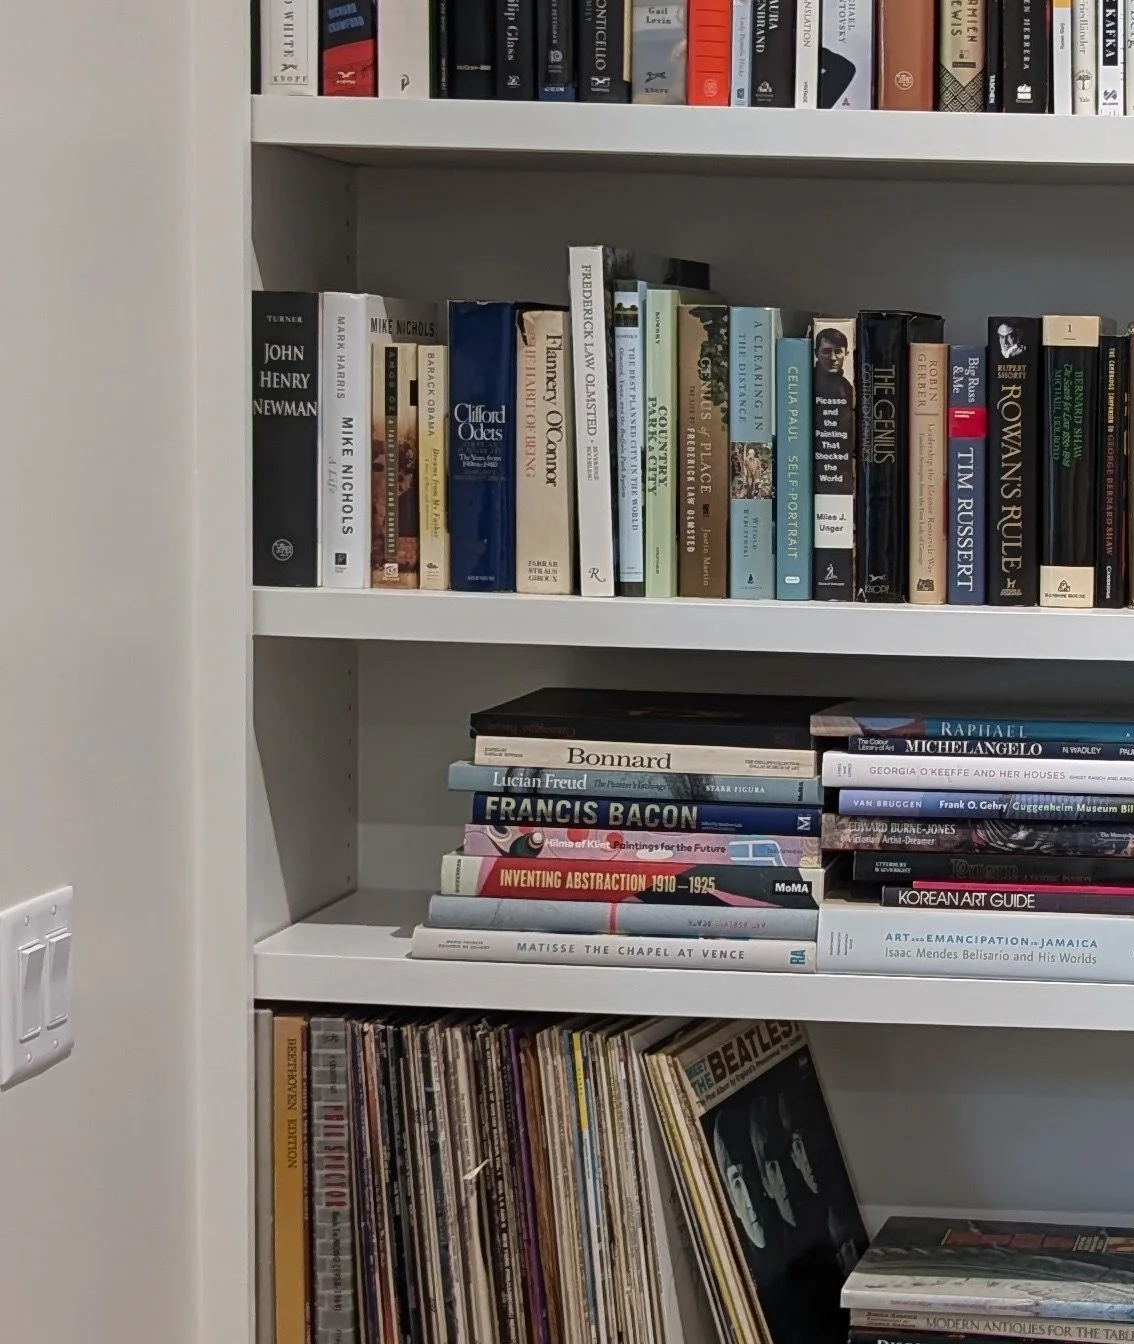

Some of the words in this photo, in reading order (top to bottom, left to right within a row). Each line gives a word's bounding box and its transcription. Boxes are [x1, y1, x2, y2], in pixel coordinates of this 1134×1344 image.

[506, 25, 518, 61] Glass
[1105, 8, 1115, 58] KAFKA
[582, 264, 595, 339] FREDERICK
[264, 343, 305, 361] JOHN
[542, 334, 563, 404] Flannery
[584, 343, 595, 370] LAW
[260, 371, 310, 389] HENRY
[427, 352, 435, 396] BARACK
[253, 400, 318, 417] NEWMAN
[427, 399, 435, 436] OBAMA
[585, 374, 597, 436] OLMSTED
[342, 417, 354, 457] MIKE
[546, 410, 563, 487] O'Connor
[997, 385, 1022, 498] ROWAN'S
[957, 447, 973, 490] TIM
[342, 464, 354, 535] NICHOLS
[956, 498, 973, 591] RUSSERT
[997, 505, 1022, 572] RULE
[567, 748, 671, 770] Bonnard
[904, 739, 1042, 756] MICHELANGELO
[493, 772, 541, 789] Lucian
[545, 773, 588, 790] Freud
[485, 796, 597, 826] FRANCIS
[608, 803, 698, 830] BACON
[775, 882, 808, 894] MoMA
[898, 890, 959, 906] KOREAN
[960, 892, 987, 907] ART
[989, 893, 1035, 908] GUIDE
[287, 1038, 297, 1110] BEETHOVEN
[287, 1119, 297, 1169] EDITION
